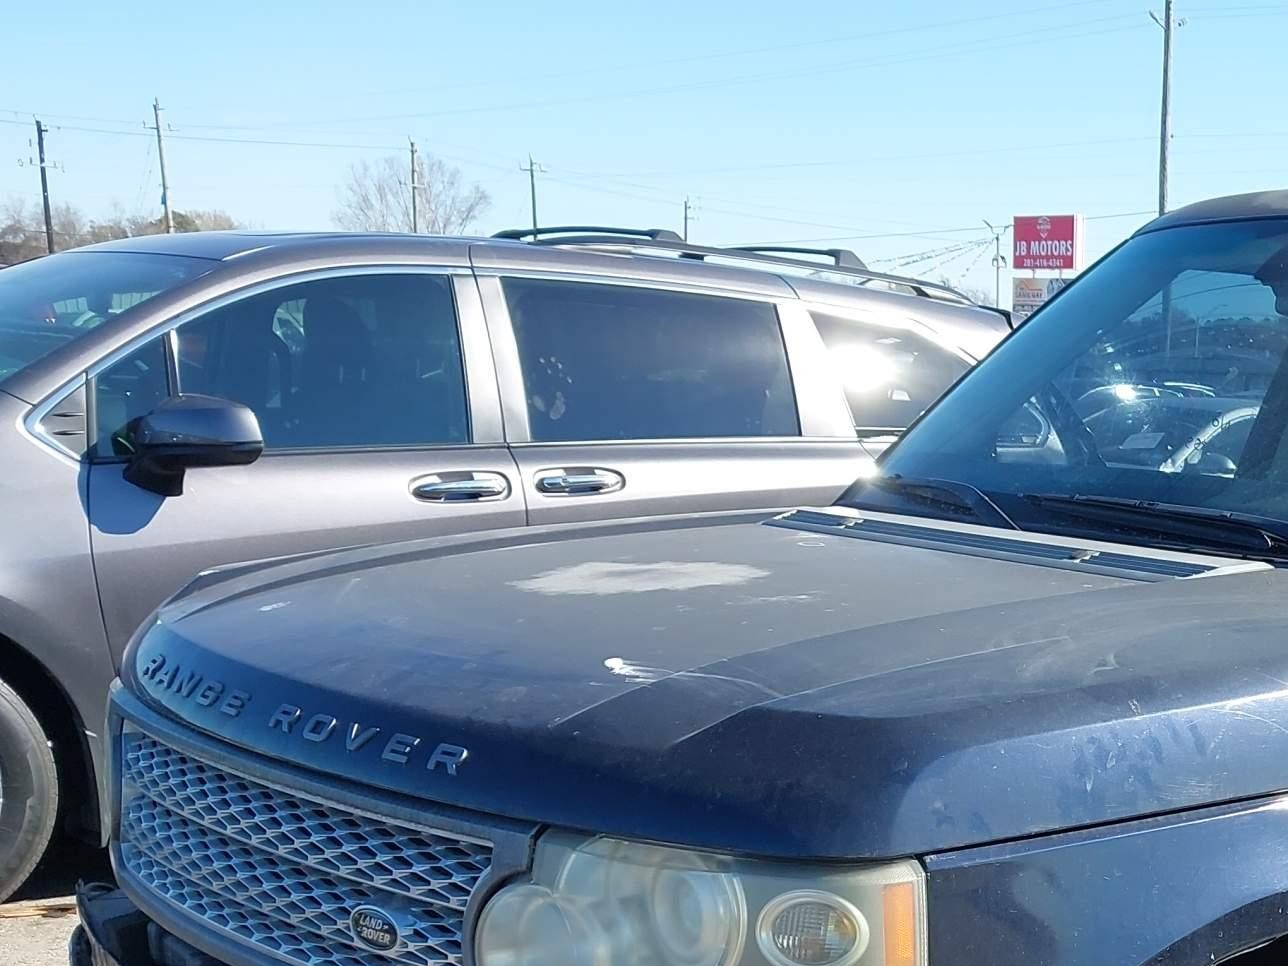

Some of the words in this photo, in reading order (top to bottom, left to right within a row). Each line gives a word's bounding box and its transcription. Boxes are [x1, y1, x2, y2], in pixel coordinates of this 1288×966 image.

[1016, 241, 1026, 256] JB
[1030, 239, 1072, 256] MOTORS
[142, 654, 253, 718] RANGE
[268, 702, 470, 776] ROVER
[360, 914, 383, 930] LAND
[361, 926, 391, 945] ROVER
